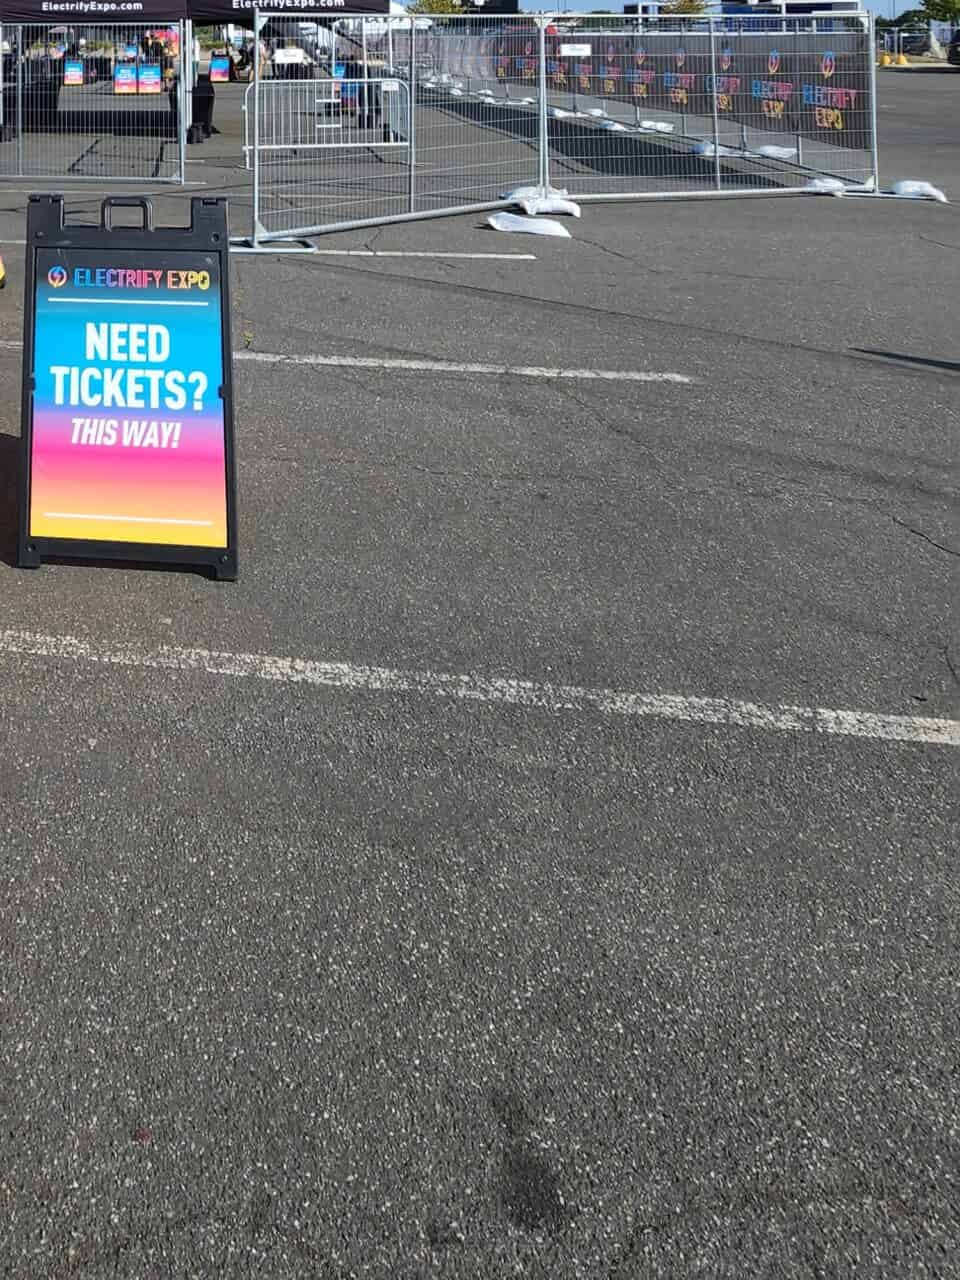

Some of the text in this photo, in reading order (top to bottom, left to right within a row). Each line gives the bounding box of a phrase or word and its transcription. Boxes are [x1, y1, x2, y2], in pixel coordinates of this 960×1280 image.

[41, 0, 143, 13] ElectrifyExpo.com
[73, 267, 210, 291] ELECTRIFY EXPO
[84, 321, 170, 363] NEED
[49, 364, 209, 411] TICKETS?
[70, 417, 182, 449] THIS WAY!
